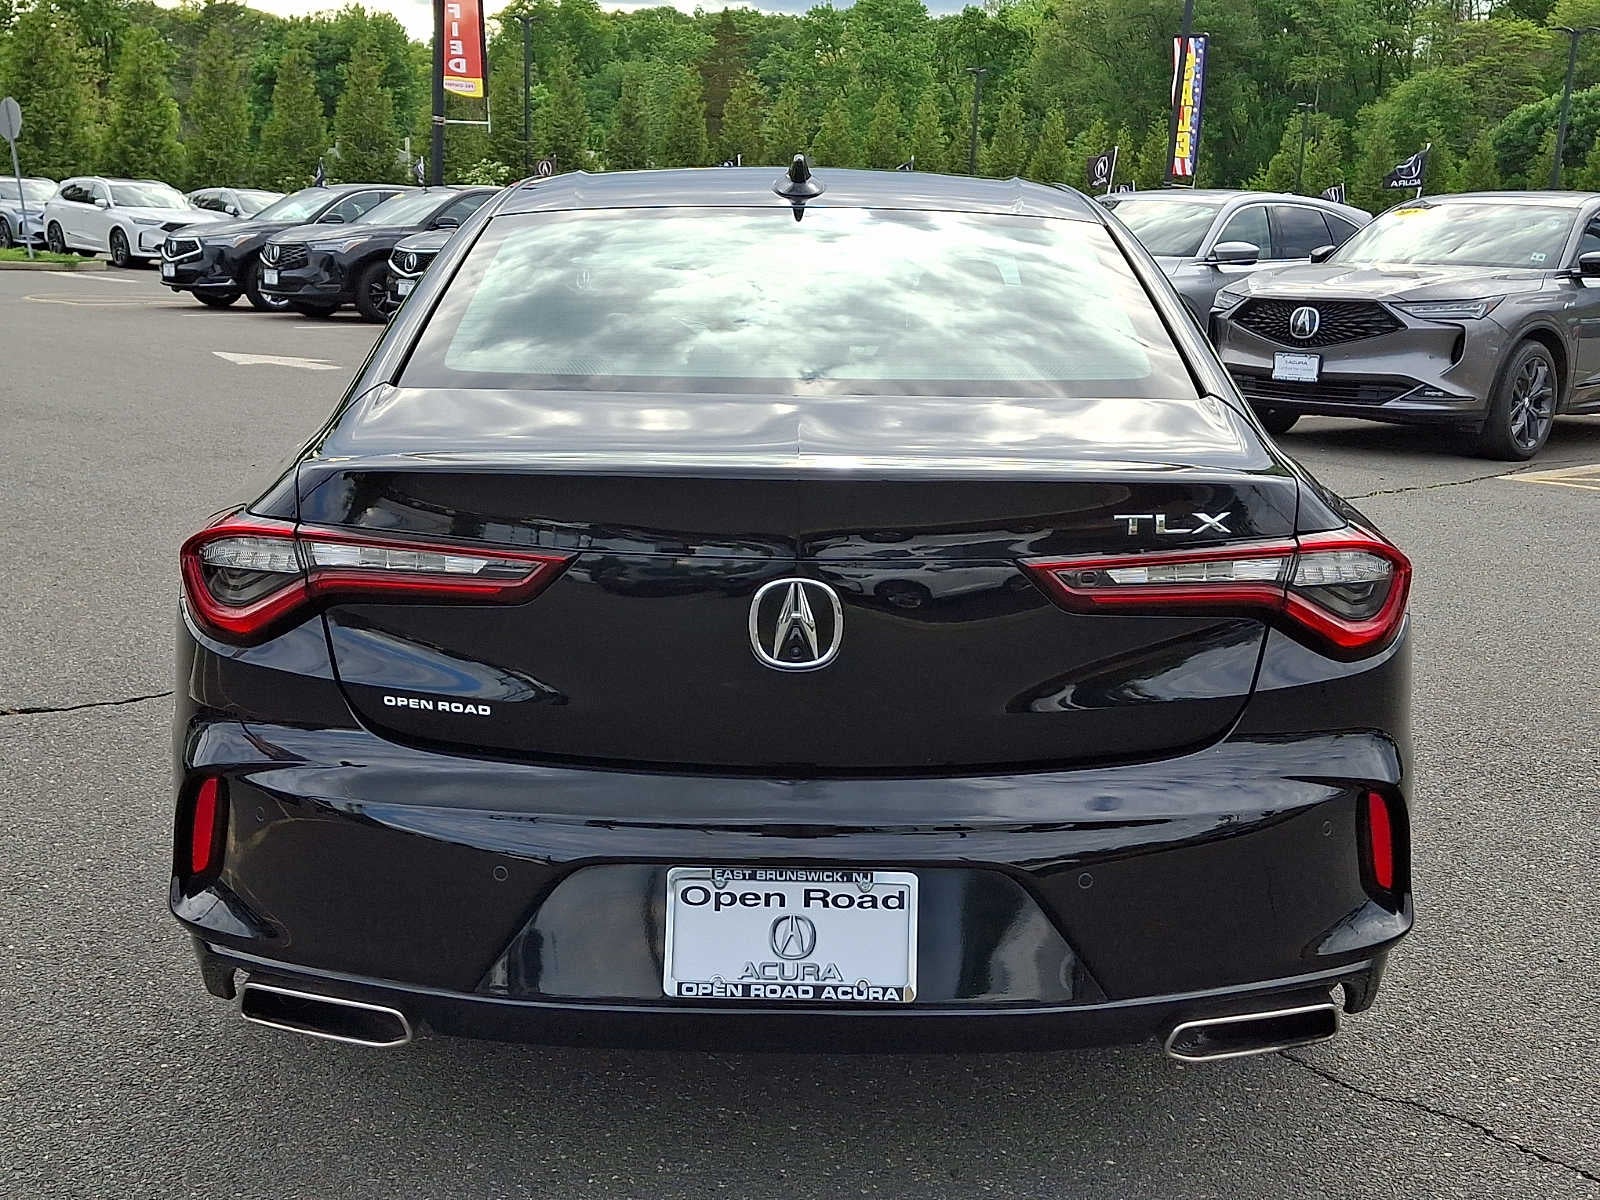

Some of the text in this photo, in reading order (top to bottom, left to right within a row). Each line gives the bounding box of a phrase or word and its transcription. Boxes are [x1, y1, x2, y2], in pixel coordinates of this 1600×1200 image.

[1113, 511, 1232, 536] TLX
[383, 695, 491, 715] OPEN ROAD
[713, 869, 752, 881] EAST
[852, 872, 873, 883] NJ
[680, 885, 905, 911] Open Road
[737, 961, 845, 982] ACURA
[681, 983, 900, 1001] OPEN ROAD ACURA
